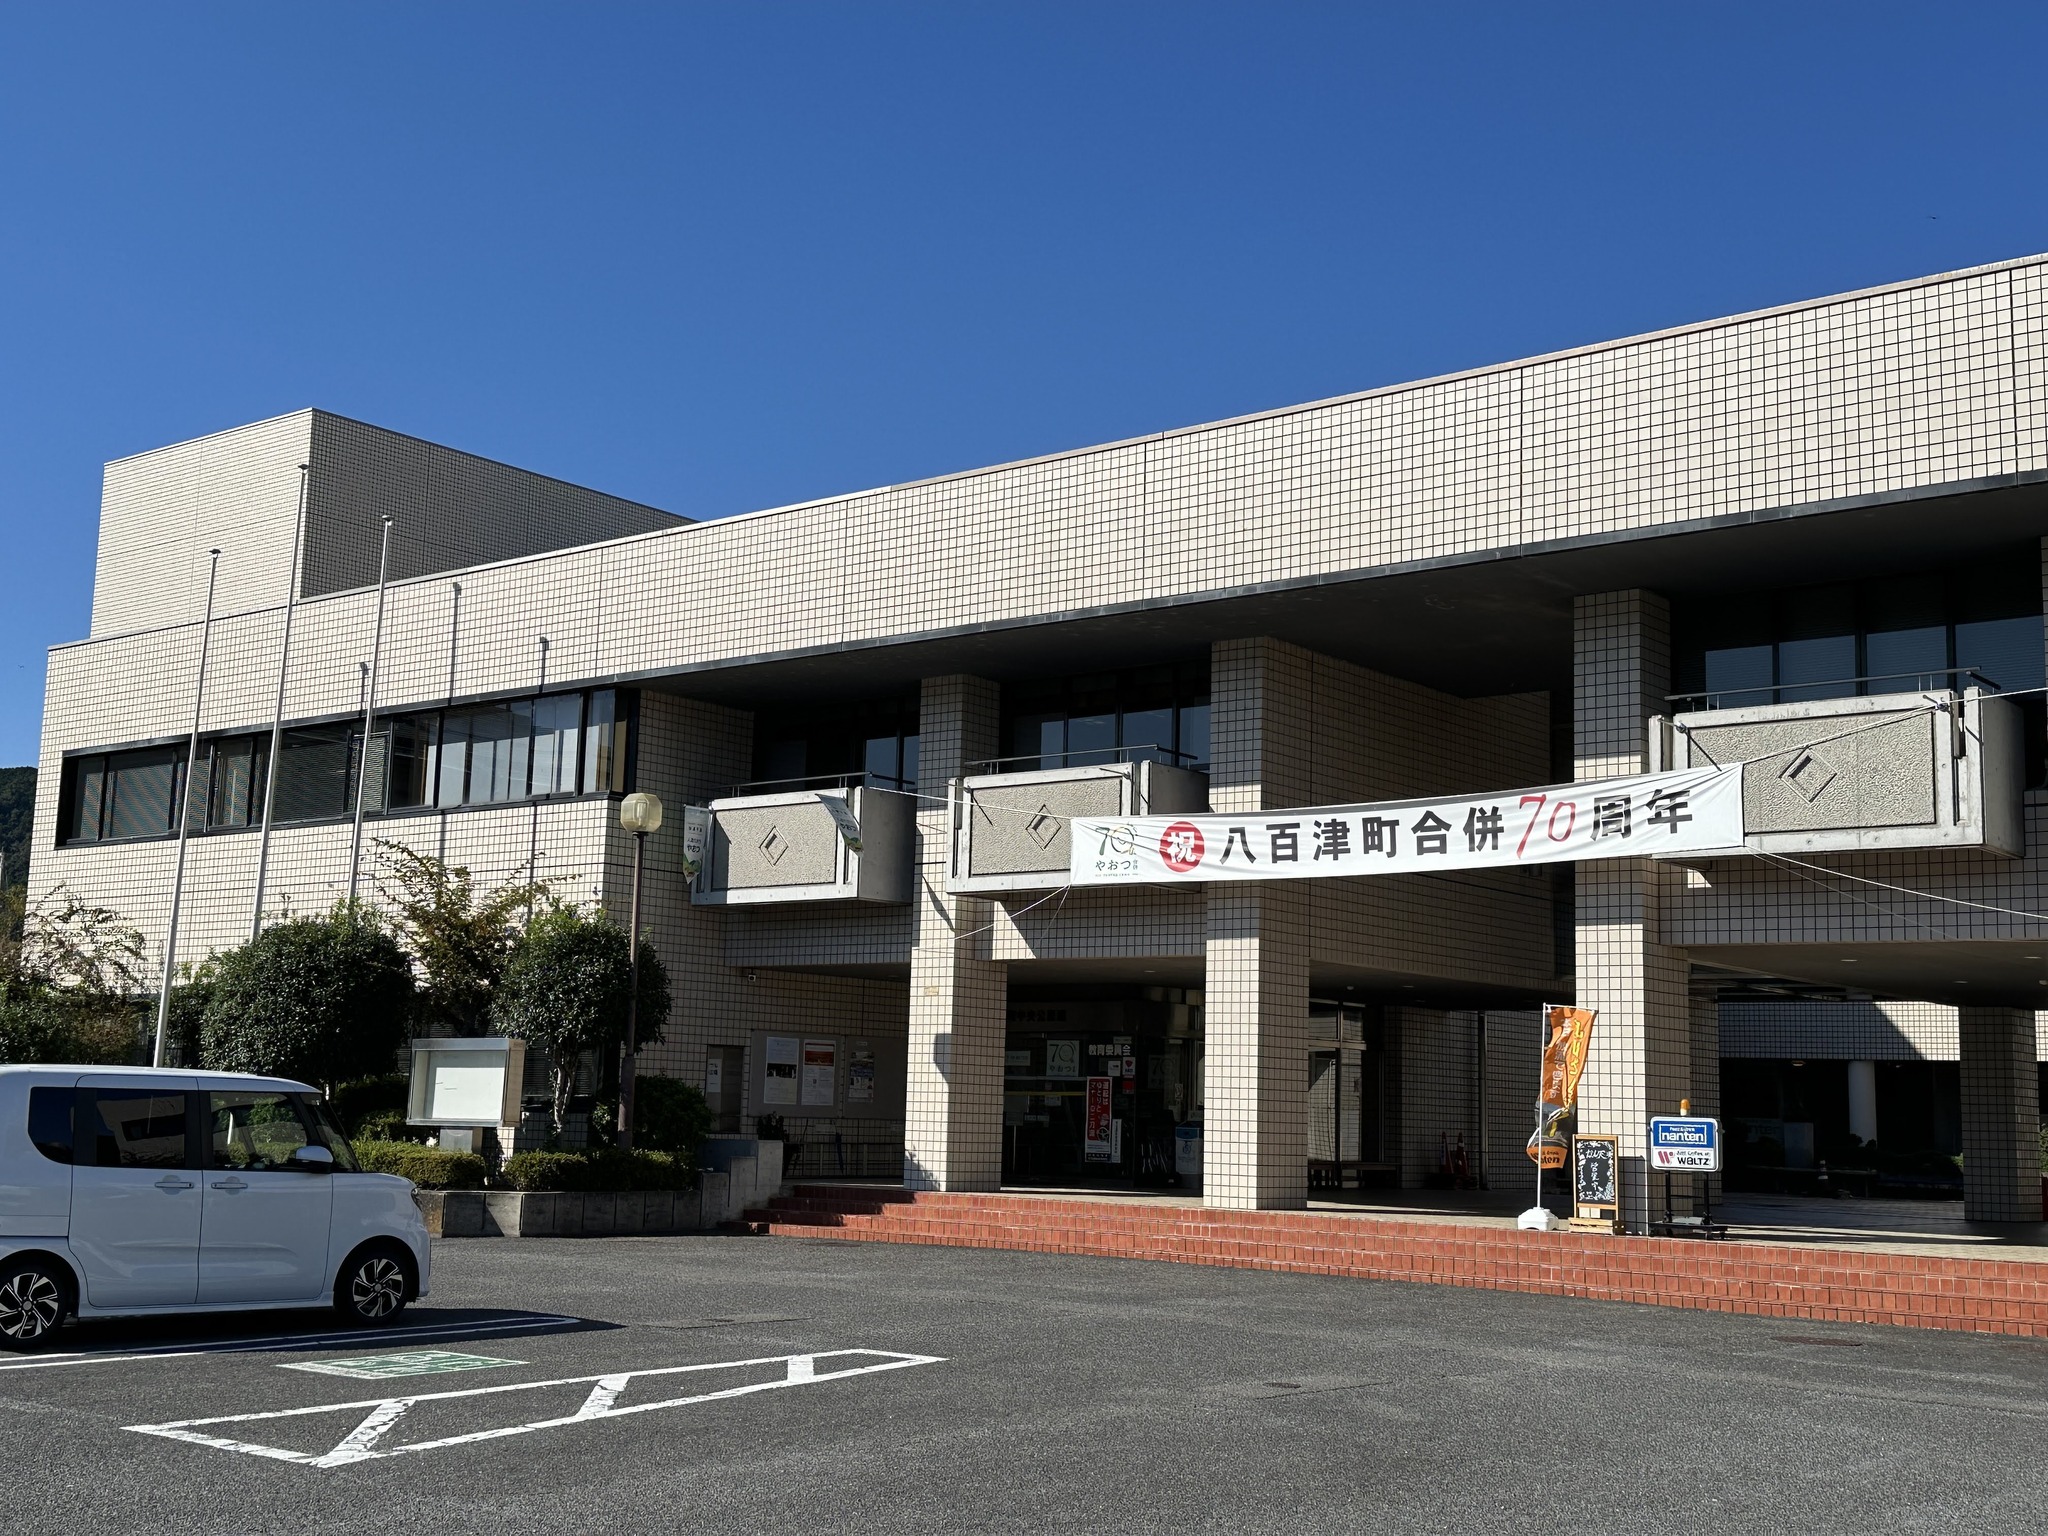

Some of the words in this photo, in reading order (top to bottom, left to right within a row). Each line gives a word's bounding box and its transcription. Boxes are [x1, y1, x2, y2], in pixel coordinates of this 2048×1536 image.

[1167, 831, 1196, 863] 祝
[1219, 788, 1693, 864] 八百津町合併70周年
[1095, 859, 1131, 871] やおつ
[1088, 1044, 1131, 1056] 教育委員会
[1661, 1131, 1704, 1141] nanten
